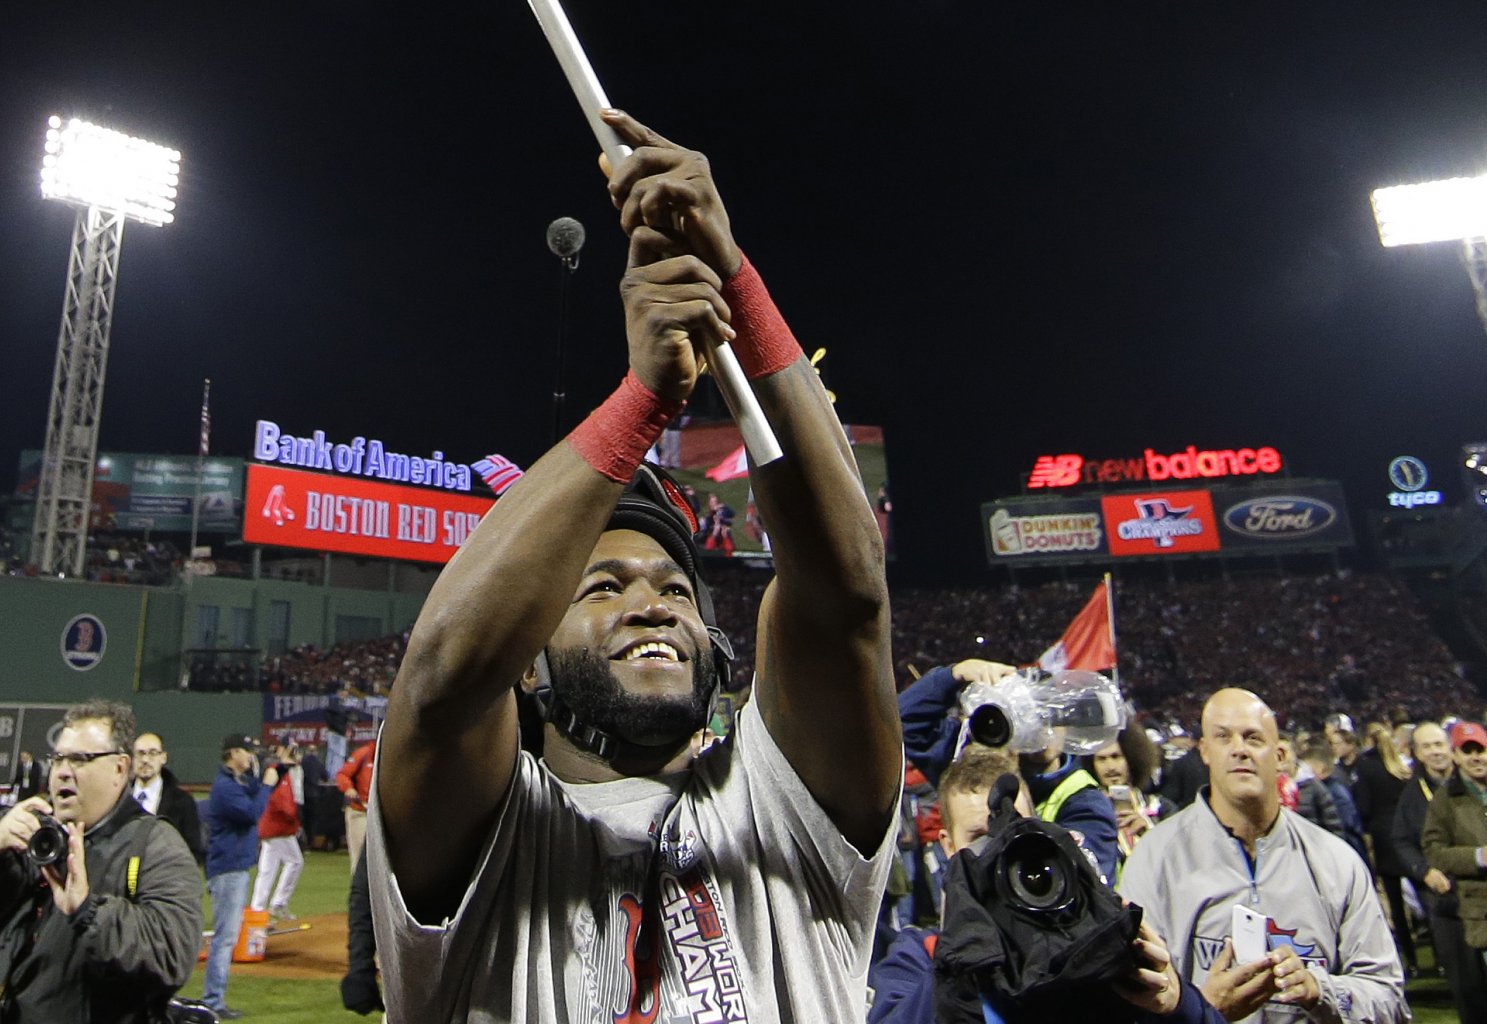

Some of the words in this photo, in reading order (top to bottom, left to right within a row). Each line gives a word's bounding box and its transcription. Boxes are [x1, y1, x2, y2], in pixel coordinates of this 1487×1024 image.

[254, 419, 334, 470] Bank
[334, 436, 365, 476] of
[364, 439, 472, 491] America
[1085, 459, 1145, 482] new
[1144, 446, 1282, 481] balance
[305, 490, 390, 538] BOSTON
[396, 503, 437, 544] RED
[1021, 516, 1100, 533] DUNKIN'
[1245, 502, 1314, 531] Ford
[1025, 532, 1099, 550] DONUTS
